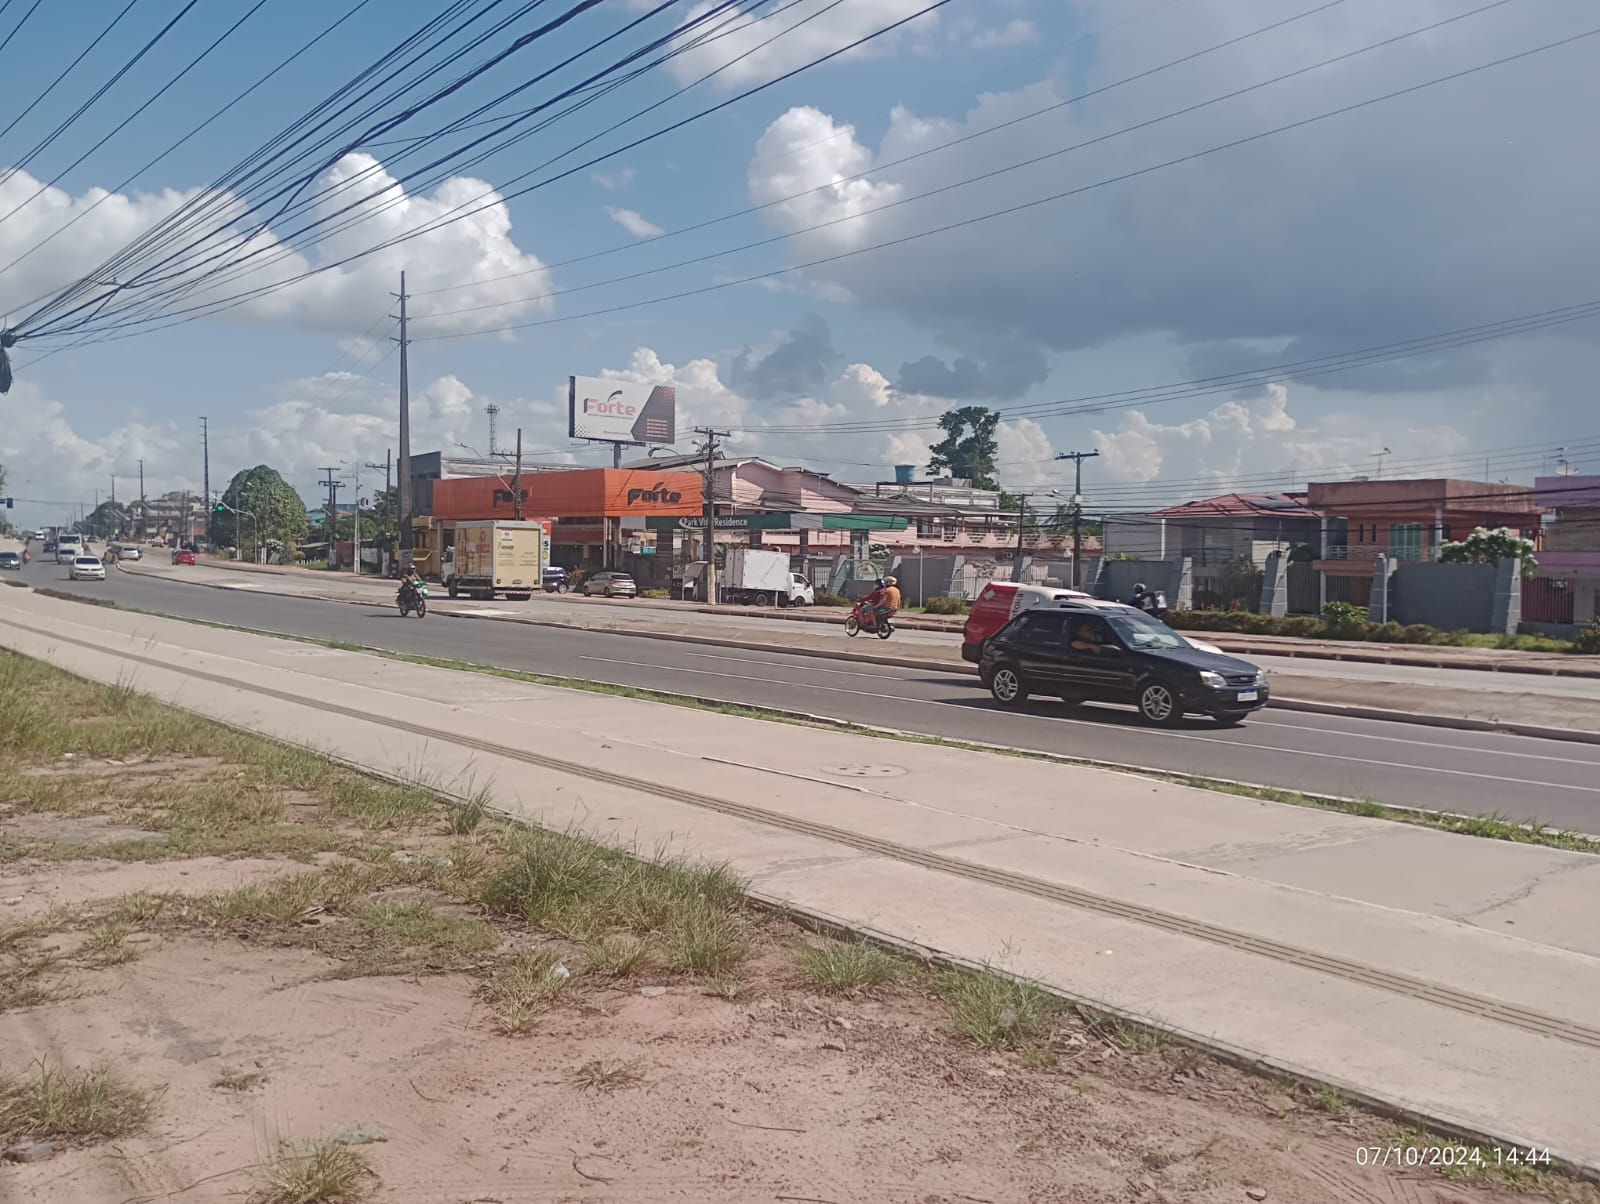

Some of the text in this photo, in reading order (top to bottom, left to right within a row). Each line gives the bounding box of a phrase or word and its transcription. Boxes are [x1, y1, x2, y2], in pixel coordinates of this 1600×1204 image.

[584, 397, 636, 416] Forte
[628, 485, 682, 506] Forte
[684, 517, 698, 526] Park
[714, 516, 748, 527] Residence
